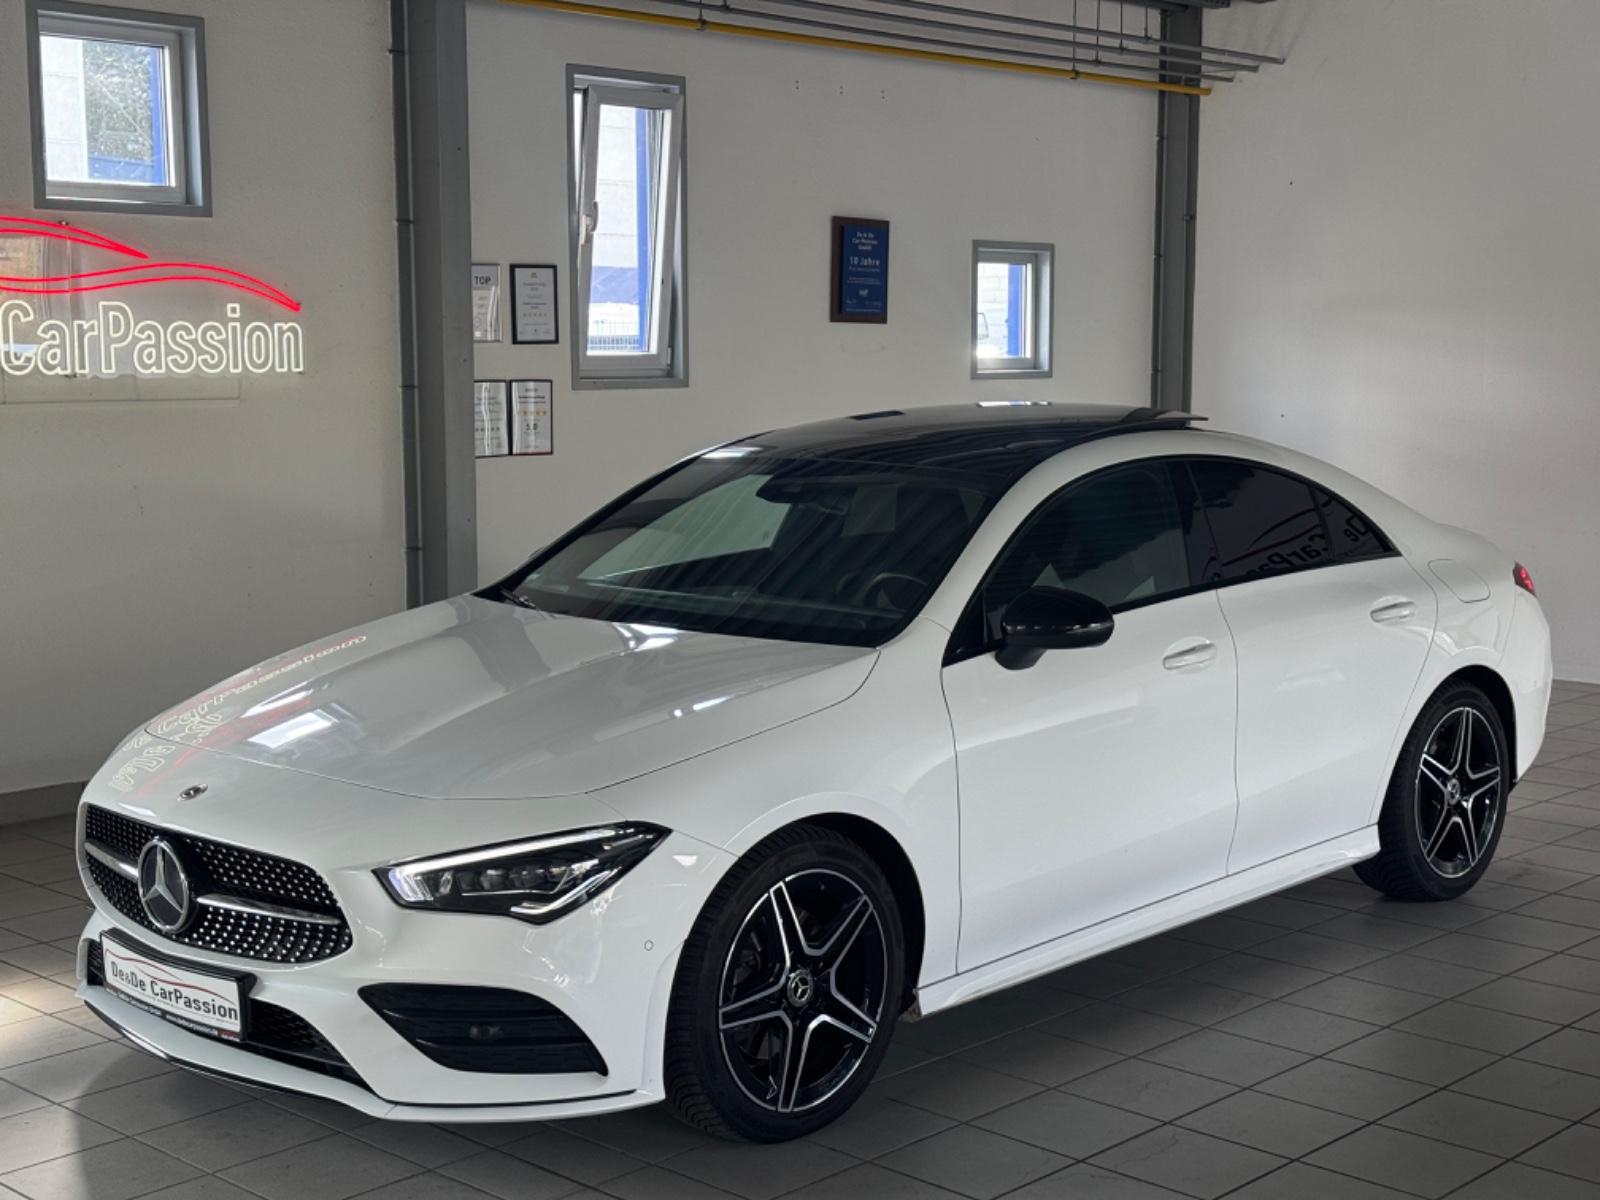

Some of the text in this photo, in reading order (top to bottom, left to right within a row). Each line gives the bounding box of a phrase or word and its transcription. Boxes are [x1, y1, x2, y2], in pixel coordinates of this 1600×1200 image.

[474, 275, 492, 286] TOP
[0, 300, 304, 374] CarPassion
[150, 980, 239, 1021] CarPassion
